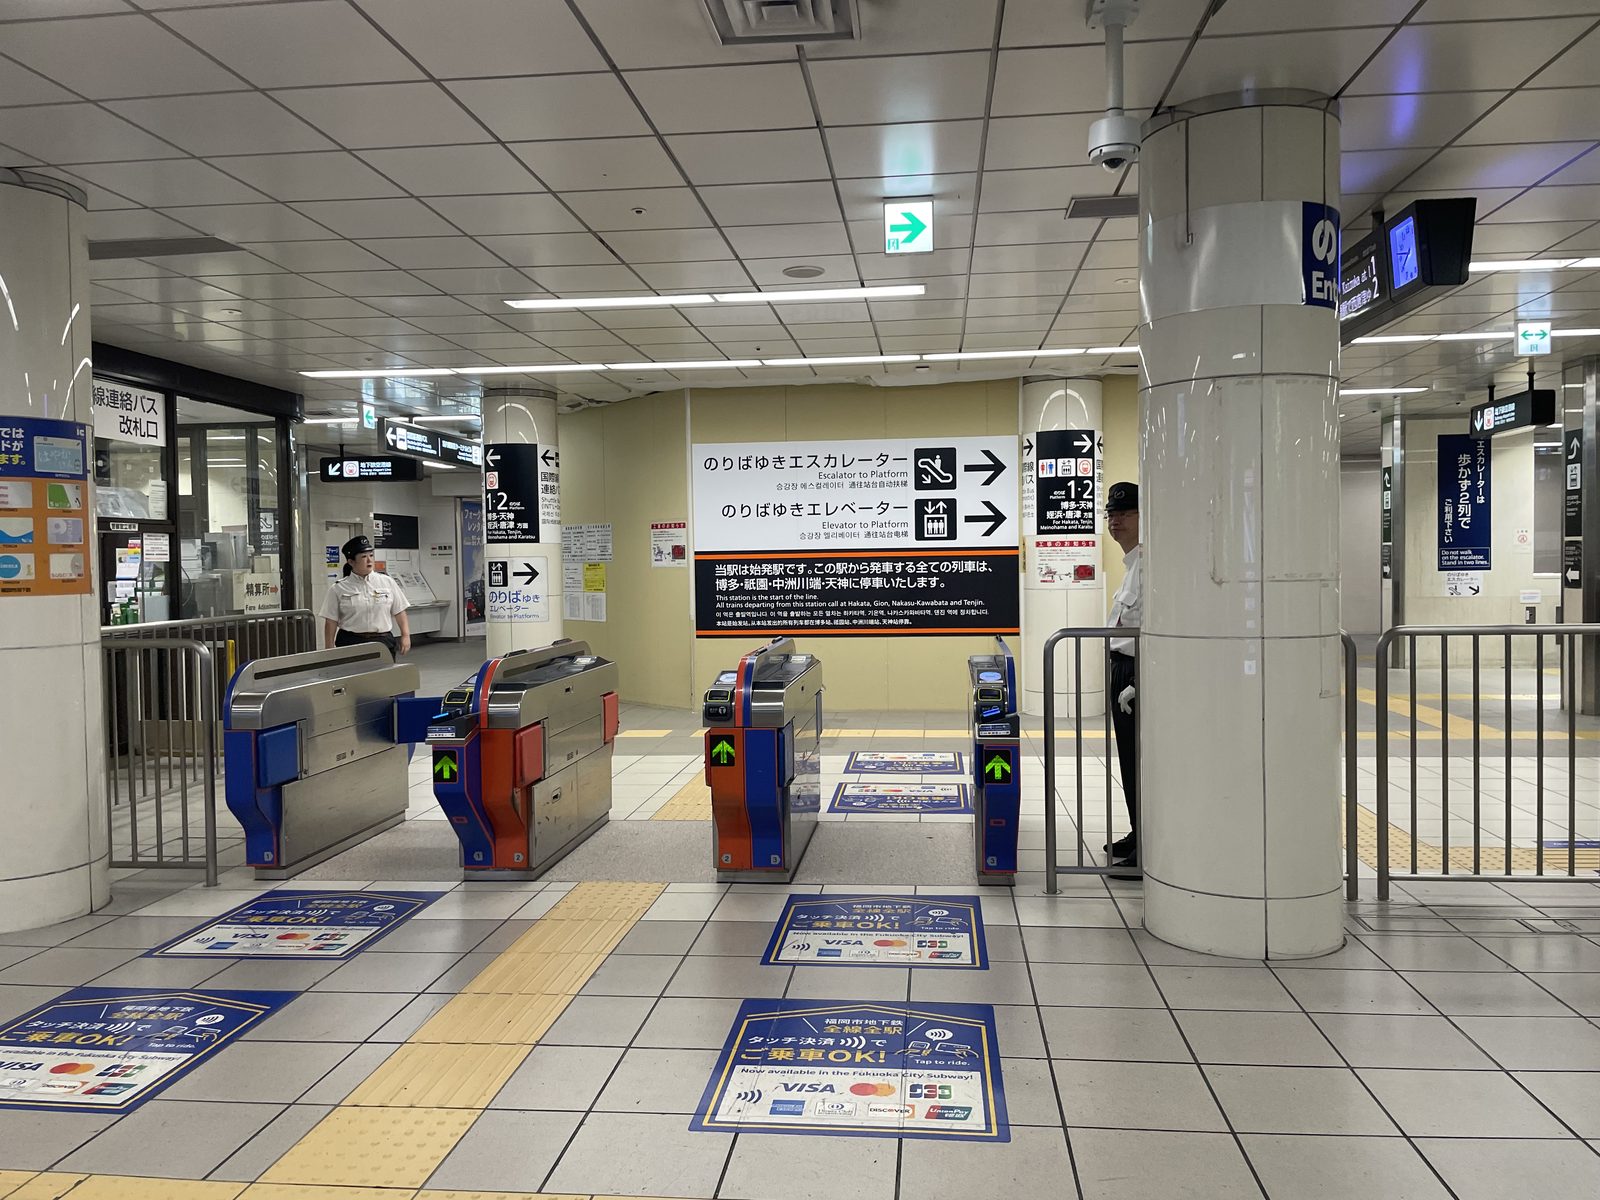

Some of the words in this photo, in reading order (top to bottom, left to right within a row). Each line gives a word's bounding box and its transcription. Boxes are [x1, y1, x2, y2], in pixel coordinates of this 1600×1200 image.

[1371, 256, 1376, 275] 1
[1372, 276, 1379, 298] 2
[119, 415, 158, 439] 改札口
[704, 453, 908, 471] のりばゆきエスカレーター
[818, 472, 856, 480] Escalator
[859, 471, 868, 479] to
[870, 470, 908, 479] Platform
[1476, 440, 1485, 504] エスカレーターは
[1457, 454, 1472, 529] 歩かず2列で
[721, 500, 908, 518] のりばゆきエレベーター
[822, 521, 857, 530] Elevator
[859, 521, 869, 530] to
[871, 520, 909, 530] Platform
[1444, 499, 1453, 543] ご利用下さい
[715, 561, 993, 577] 当駅は始発駅です。この駅から発車する全ての列車は、
[246, 583, 270, 596] 精算所
[489, 590, 540, 603] のりばゆき
[744, 601, 775, 609] departing
[848, 600, 872, 608] Hakata,
[873, 600, 891, 608] Gion,
[963, 599, 985, 607] Tenjin.
[824, 1018, 904, 1026] 福岡市地下鉄
[823, 1025, 903, 1035] 全線全駅
[748, 1036, 836, 1046] タッチ決済
[871, 1039, 888, 1047] で
[740, 1047, 887, 1063] ご乗車OK!
[914, 1058, 933, 1066] Tap
[768, 1068, 817, 1076] available
[852, 1070, 899, 1078] Fukuoka
[902, 1071, 925, 1079] City
[927, 1072, 974, 1080] Subway!
[781, 1082, 836, 1093] VISA
[909, 1084, 952, 1100] JCB
[928, 1107, 970, 1115] UnionPay
